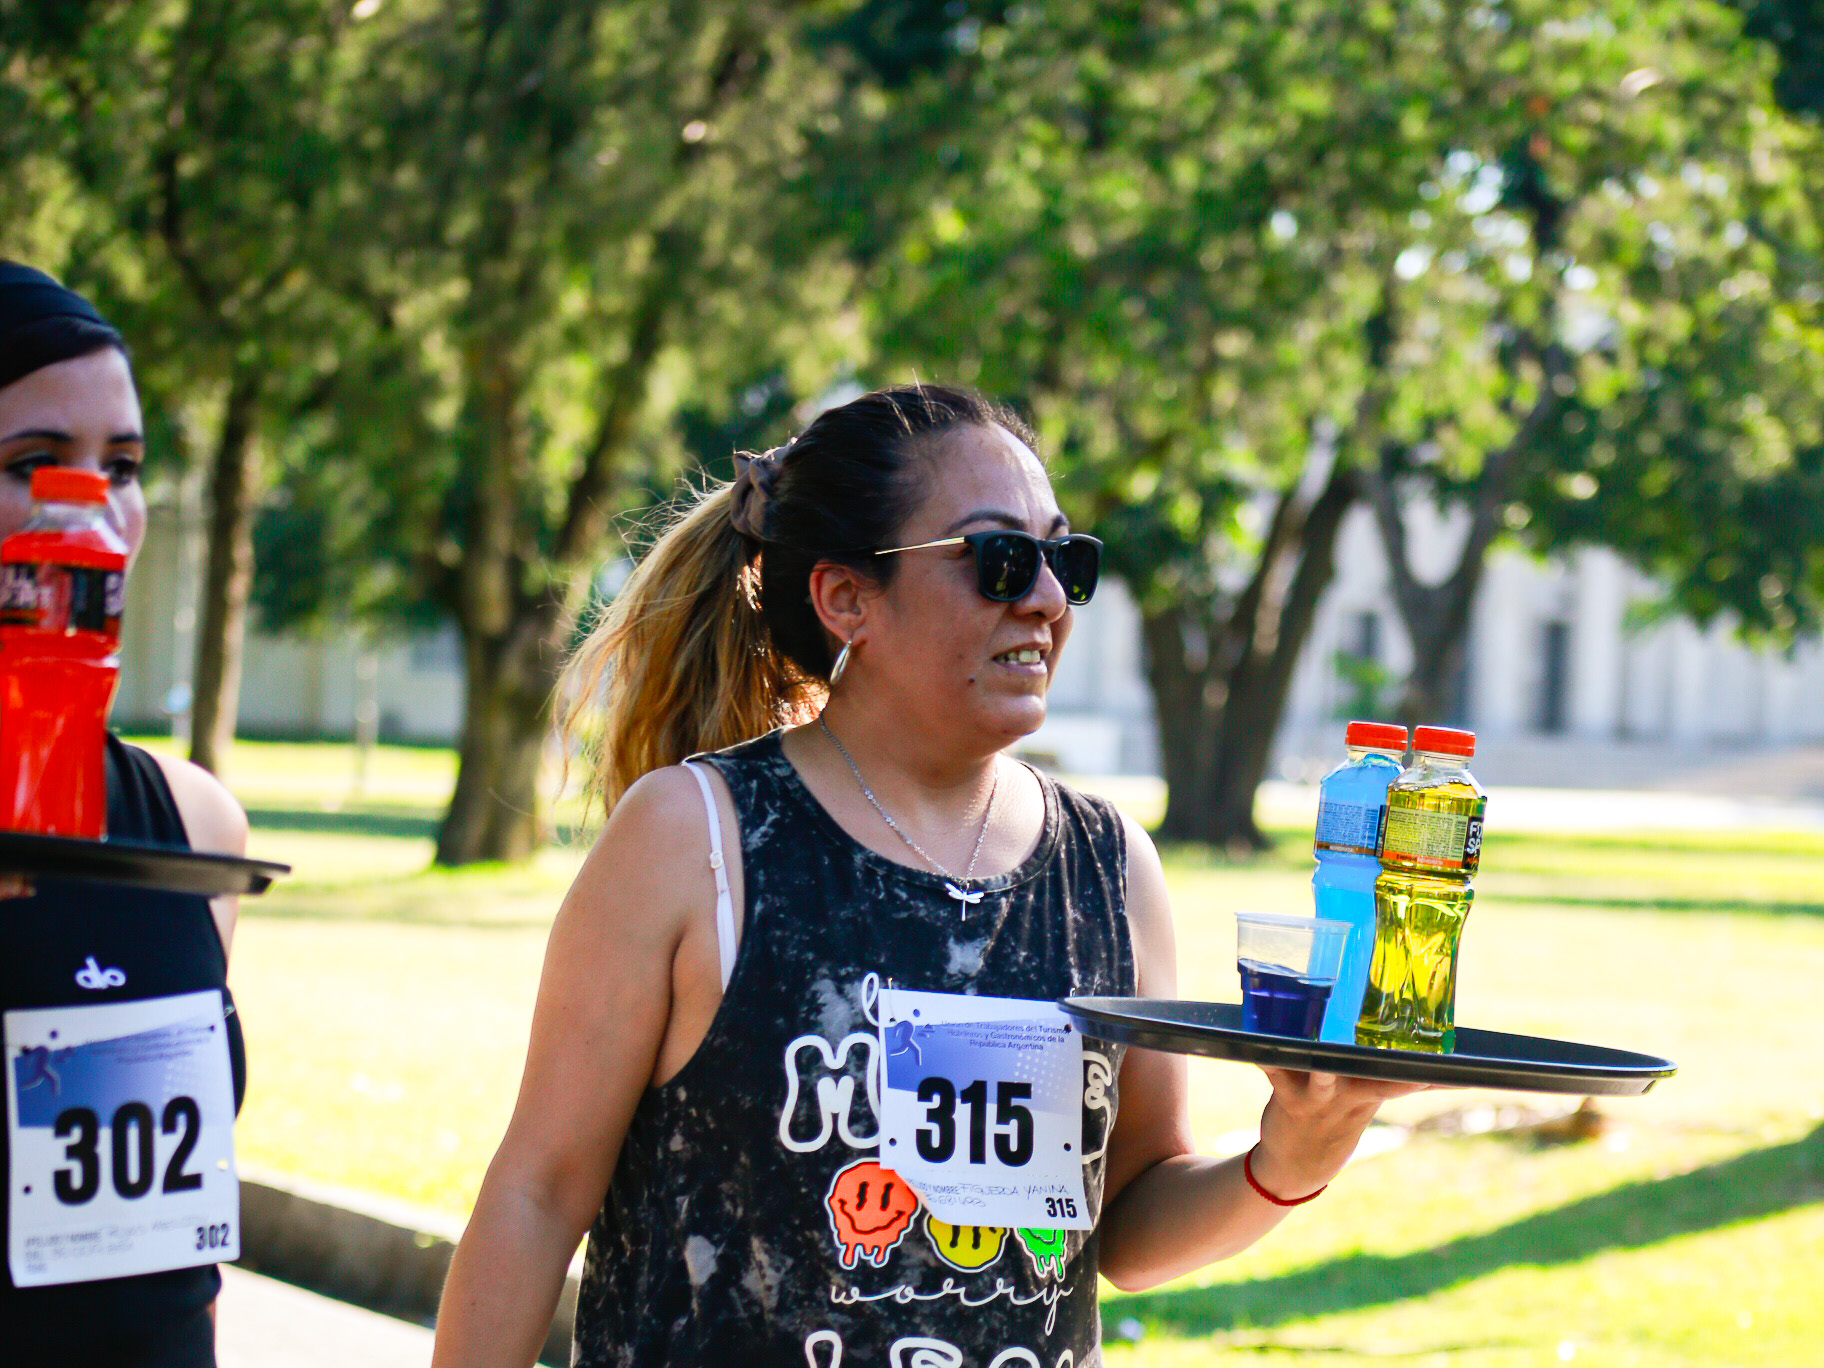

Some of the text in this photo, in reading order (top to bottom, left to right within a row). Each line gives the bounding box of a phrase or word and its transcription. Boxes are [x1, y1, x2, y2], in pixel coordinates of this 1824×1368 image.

[975, 1022, 1024, 1033] Trabajadores
[1025, 1025, 1038, 1033] del
[1047, 1034, 1056, 1043] de
[1057, 1035, 1065, 1043] la
[1008, 1041, 1044, 1051] Argentina
[915, 1076, 1034, 1168] 315
[53, 1095, 203, 1206] 302
[1045, 1197, 1078, 1219] 315
[196, 1223, 230, 1250] 302
[830, 1277, 1074, 1336] worry
